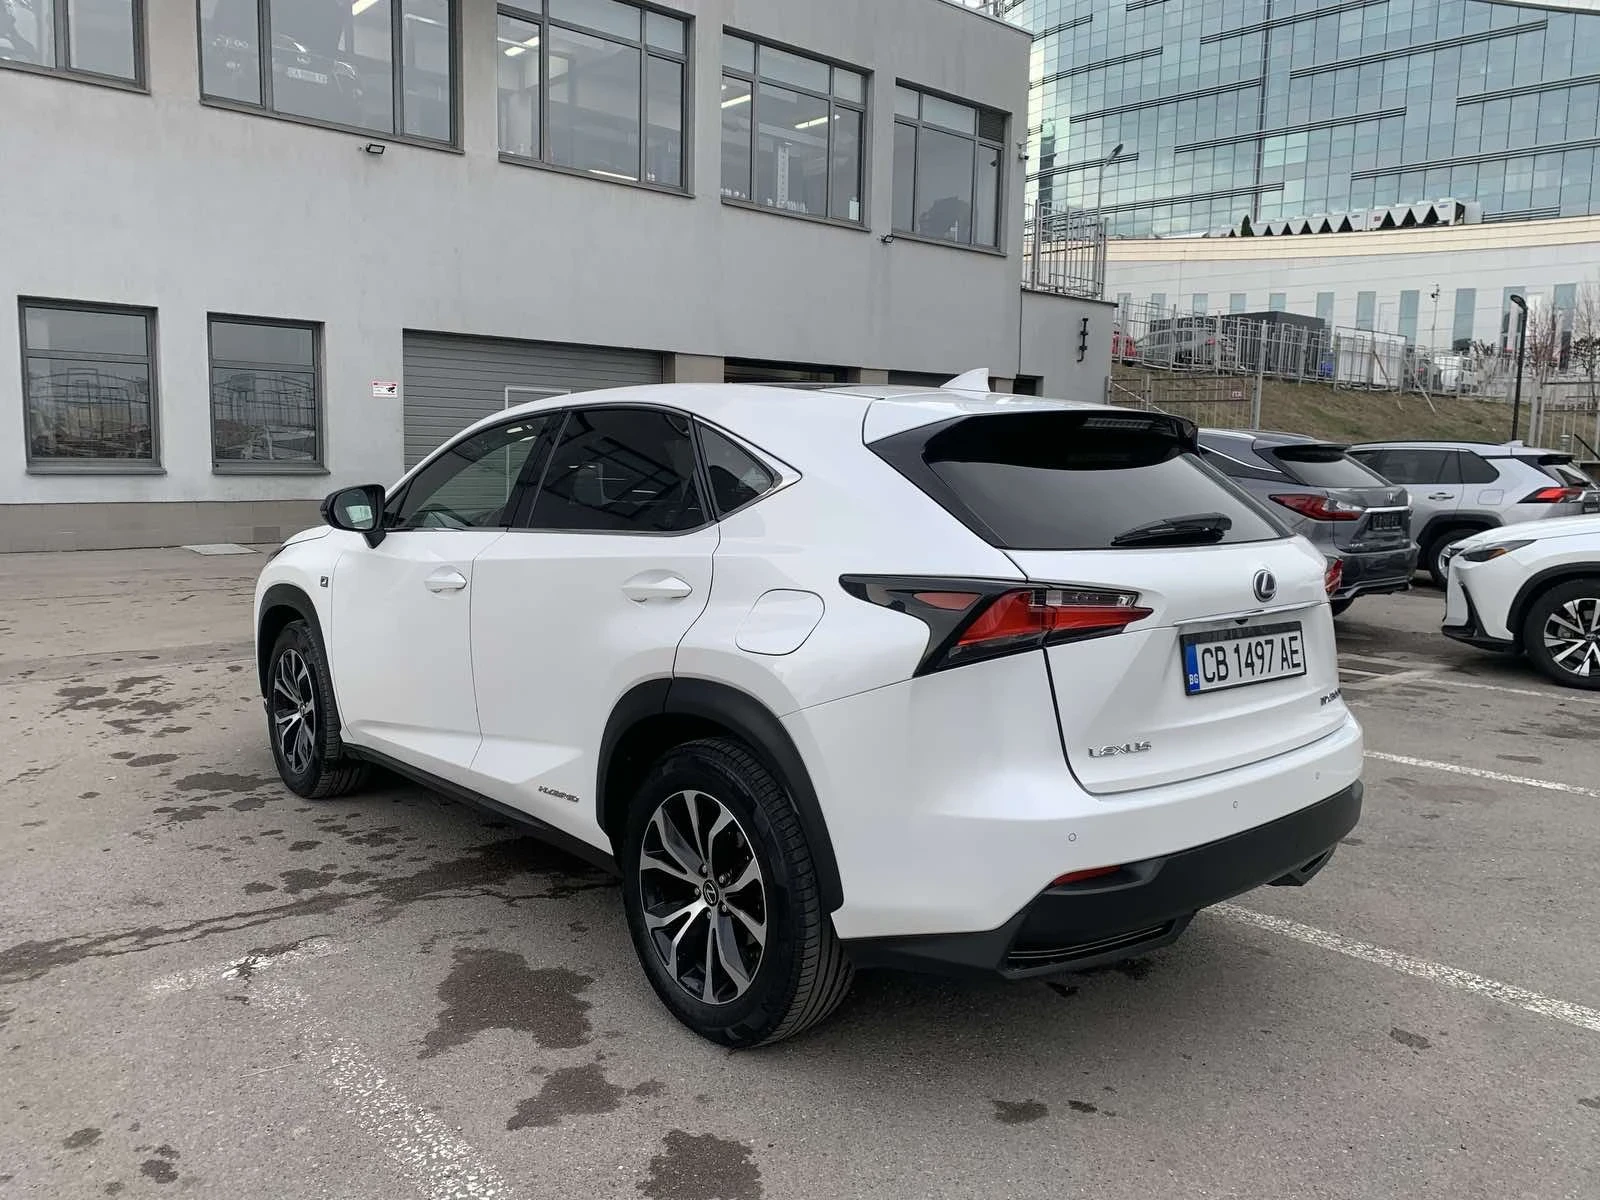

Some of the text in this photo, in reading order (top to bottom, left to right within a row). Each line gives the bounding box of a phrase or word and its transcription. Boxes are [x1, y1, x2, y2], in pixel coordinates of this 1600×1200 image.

[1201, 635, 1302, 683] CB 1497 AE
[1188, 673, 1199, 686] BG
[1087, 741, 1152, 759] LEXUS
